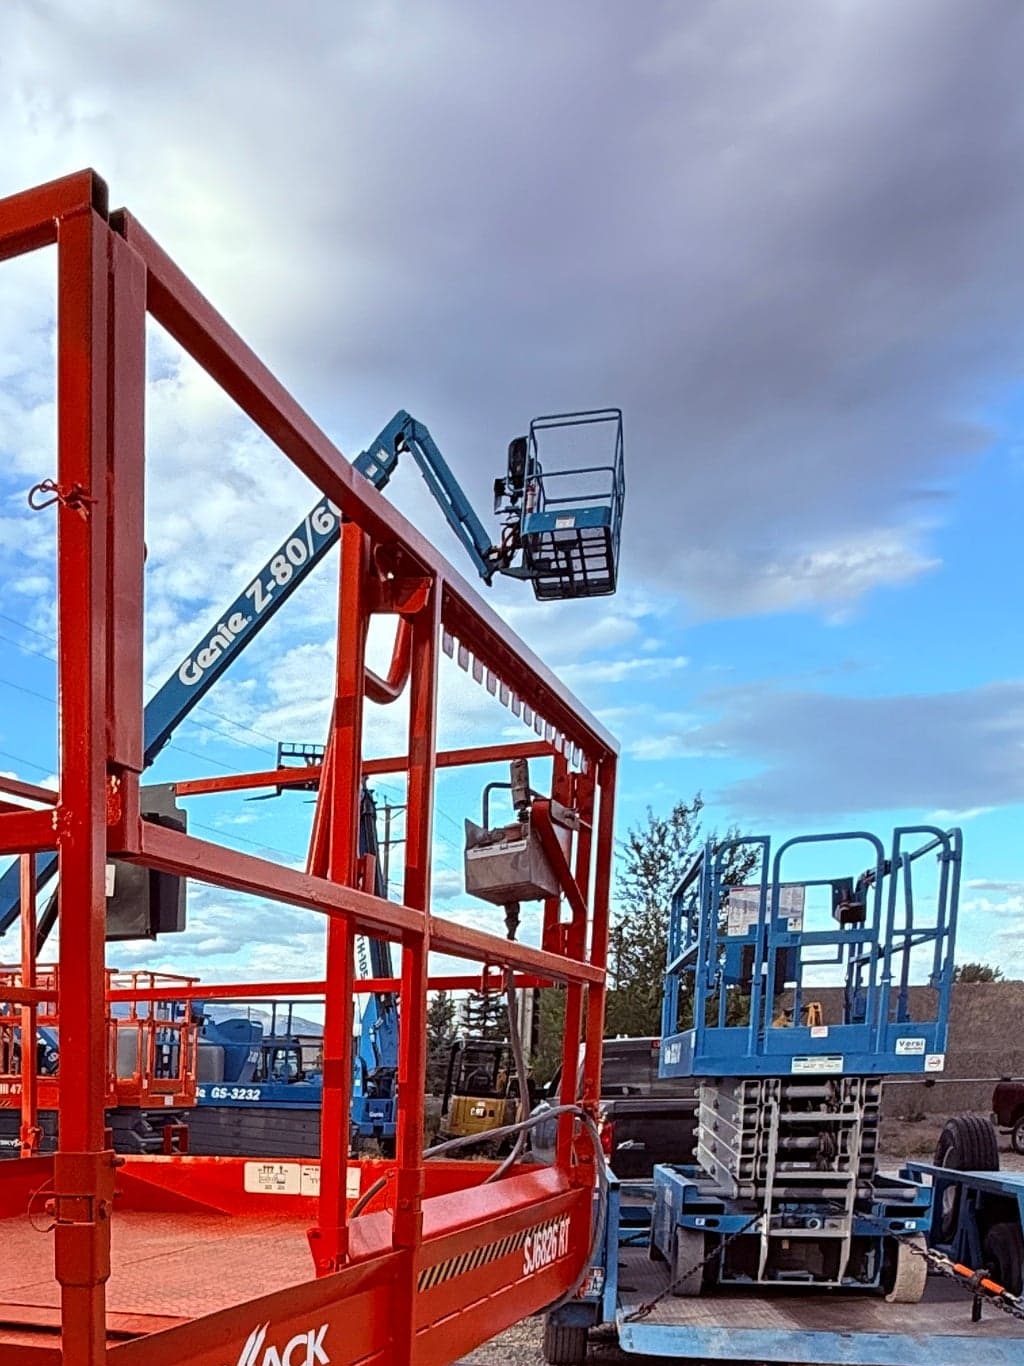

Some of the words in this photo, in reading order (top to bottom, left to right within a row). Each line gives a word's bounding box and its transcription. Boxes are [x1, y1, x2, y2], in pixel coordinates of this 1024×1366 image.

[179, 612, 249, 686] Genie
[10, 1083, 23, 1095] 47
[211, 1087, 261, 1100] GS-3232
[558, 1217, 571, 1256] RT
